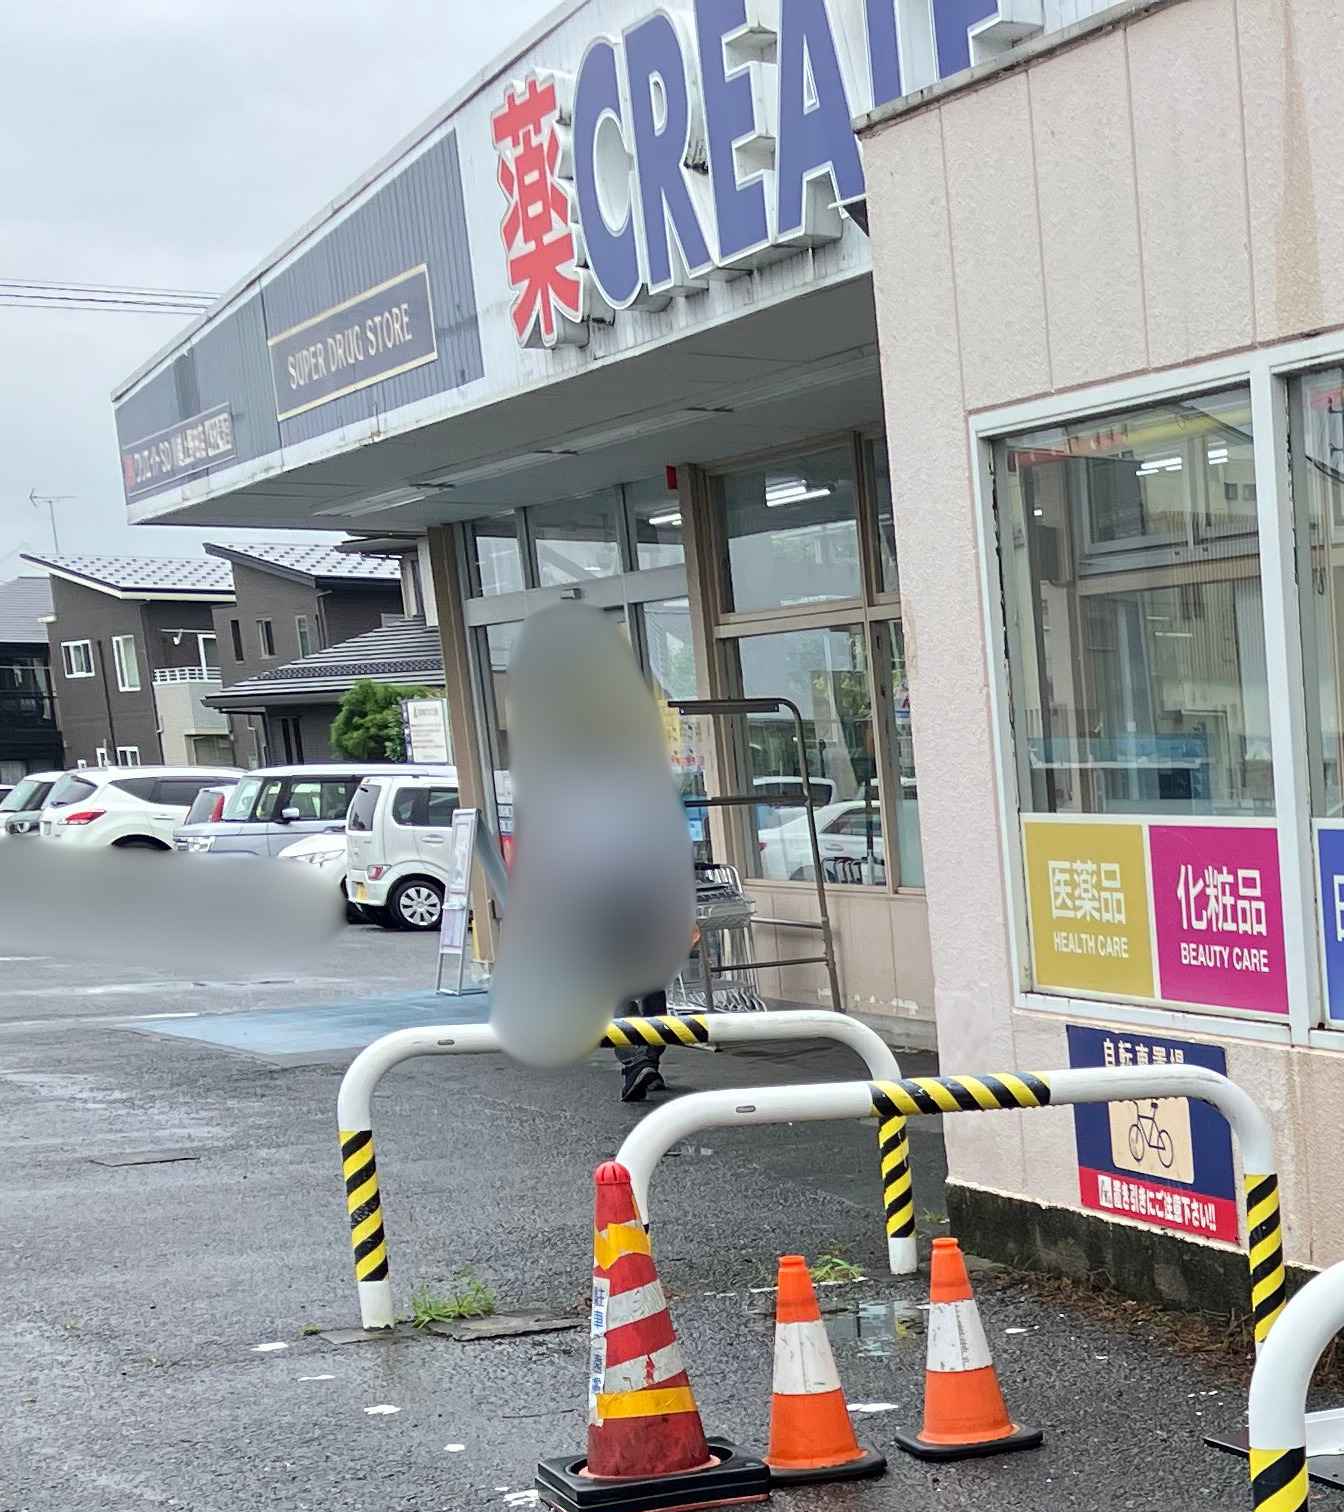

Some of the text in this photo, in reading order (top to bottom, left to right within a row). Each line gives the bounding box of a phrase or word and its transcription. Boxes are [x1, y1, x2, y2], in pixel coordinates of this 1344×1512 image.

[571, 0, 1002, 309] CREA
[491, 76, 583, 346] 薬
[287, 303, 413, 390] SUPER DRUG STORE
[1048, 860, 1127, 925] 医薬品
[1177, 864, 1268, 936] 化粧品
[1053, 931, 1129, 959] HEALTH CARE
[1179, 942, 1270, 973] BEAUTY CARE
